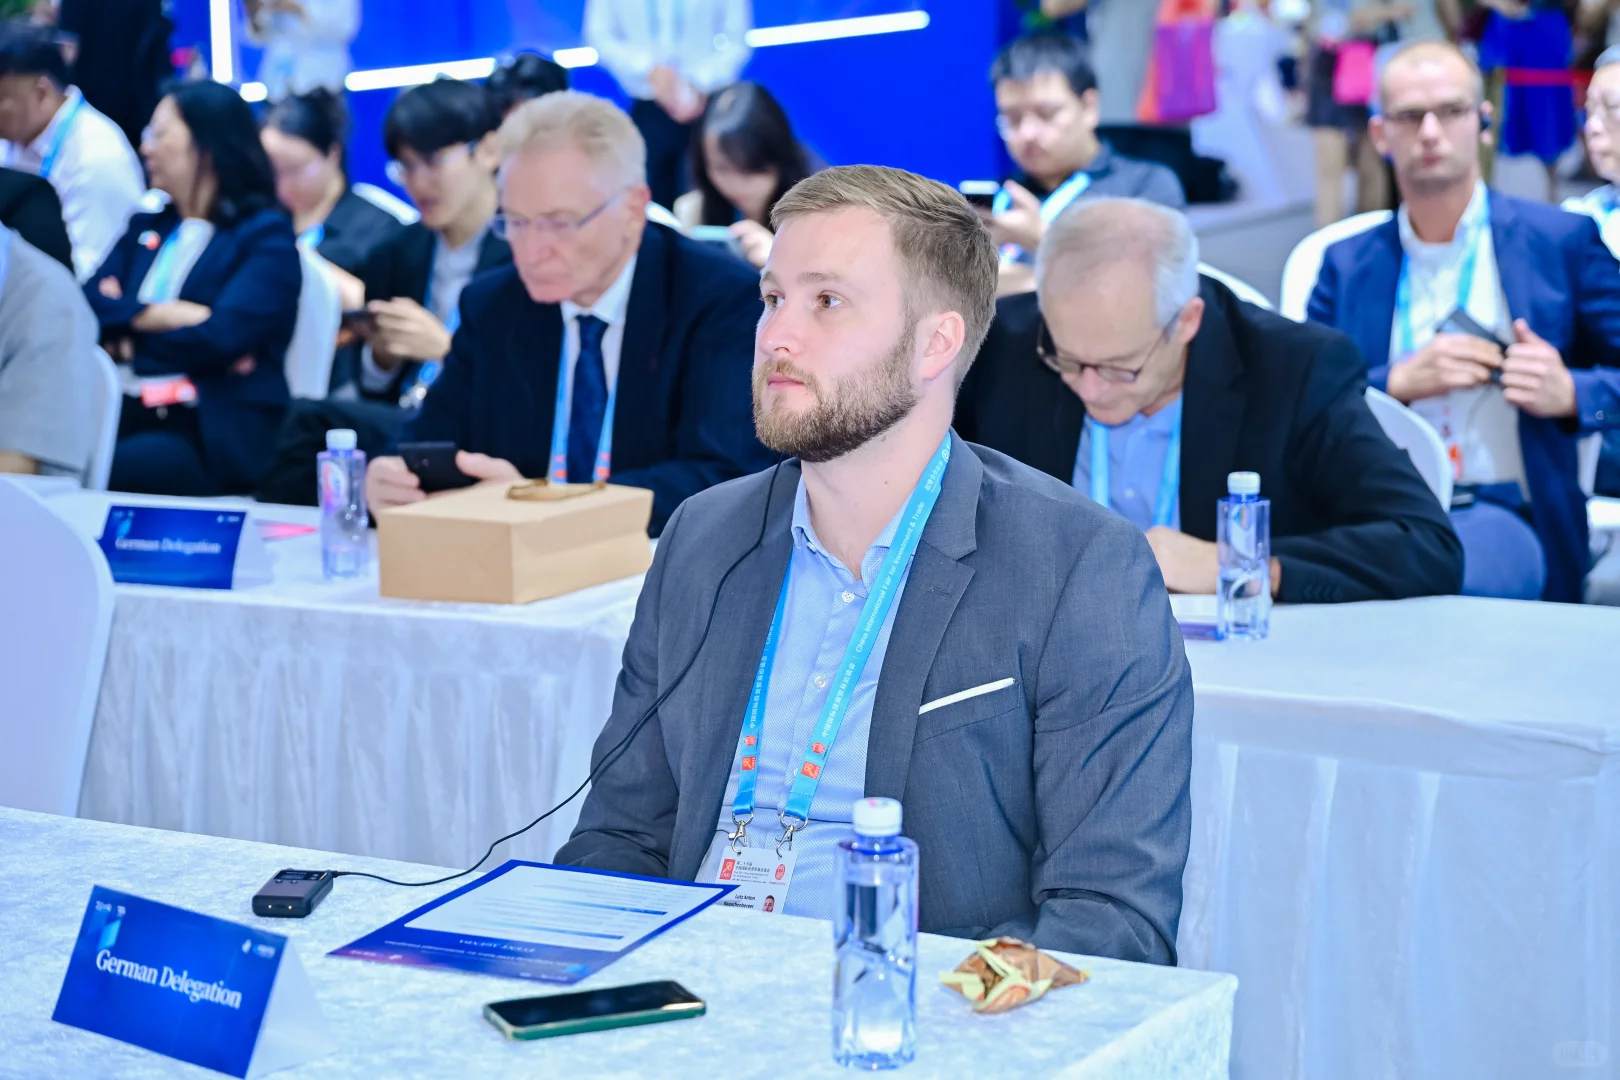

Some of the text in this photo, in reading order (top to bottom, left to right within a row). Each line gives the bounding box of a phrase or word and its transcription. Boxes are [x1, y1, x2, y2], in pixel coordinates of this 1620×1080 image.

[855, 501, 925, 653] China International Fair for Investment & Trade
[96, 949, 242, 1009] German Delegation
